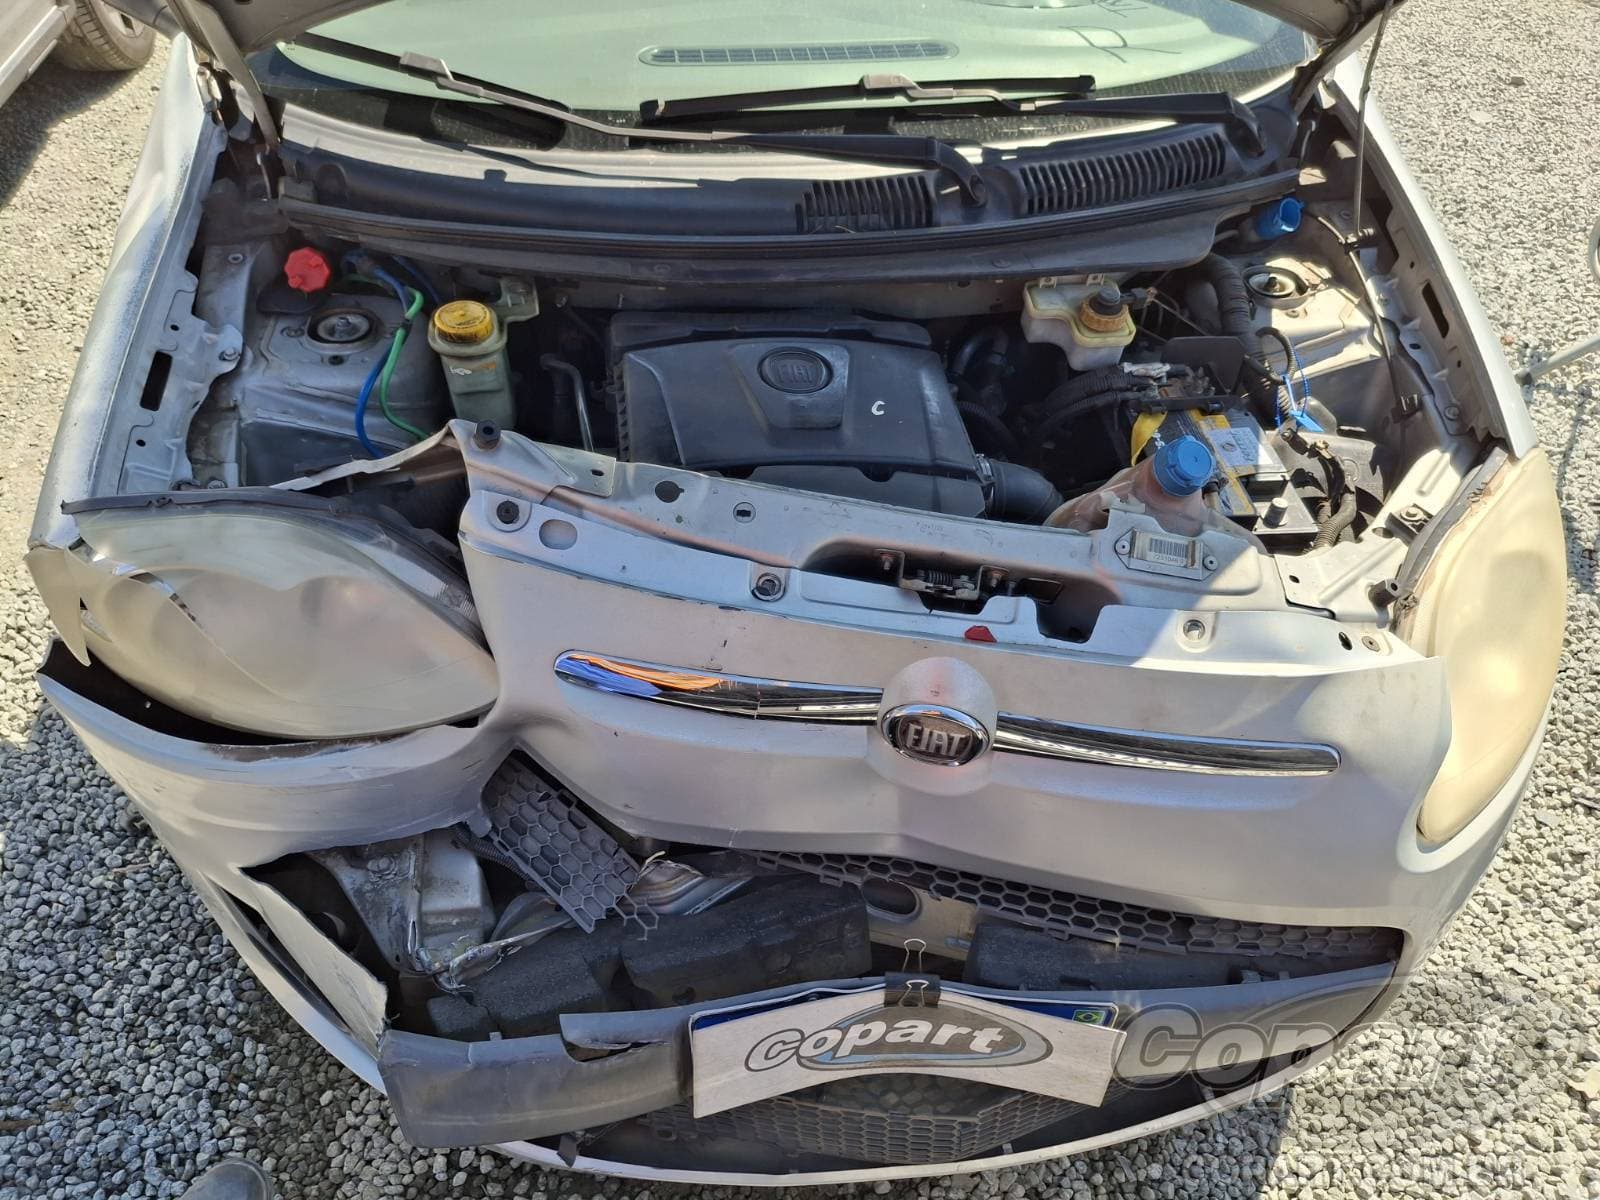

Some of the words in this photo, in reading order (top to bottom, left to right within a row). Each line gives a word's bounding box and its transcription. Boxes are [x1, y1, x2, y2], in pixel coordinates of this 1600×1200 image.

[871, 400, 886, 416] C
[906, 722, 969, 756] FIAT
[745, 1018, 1004, 1072] Copart
